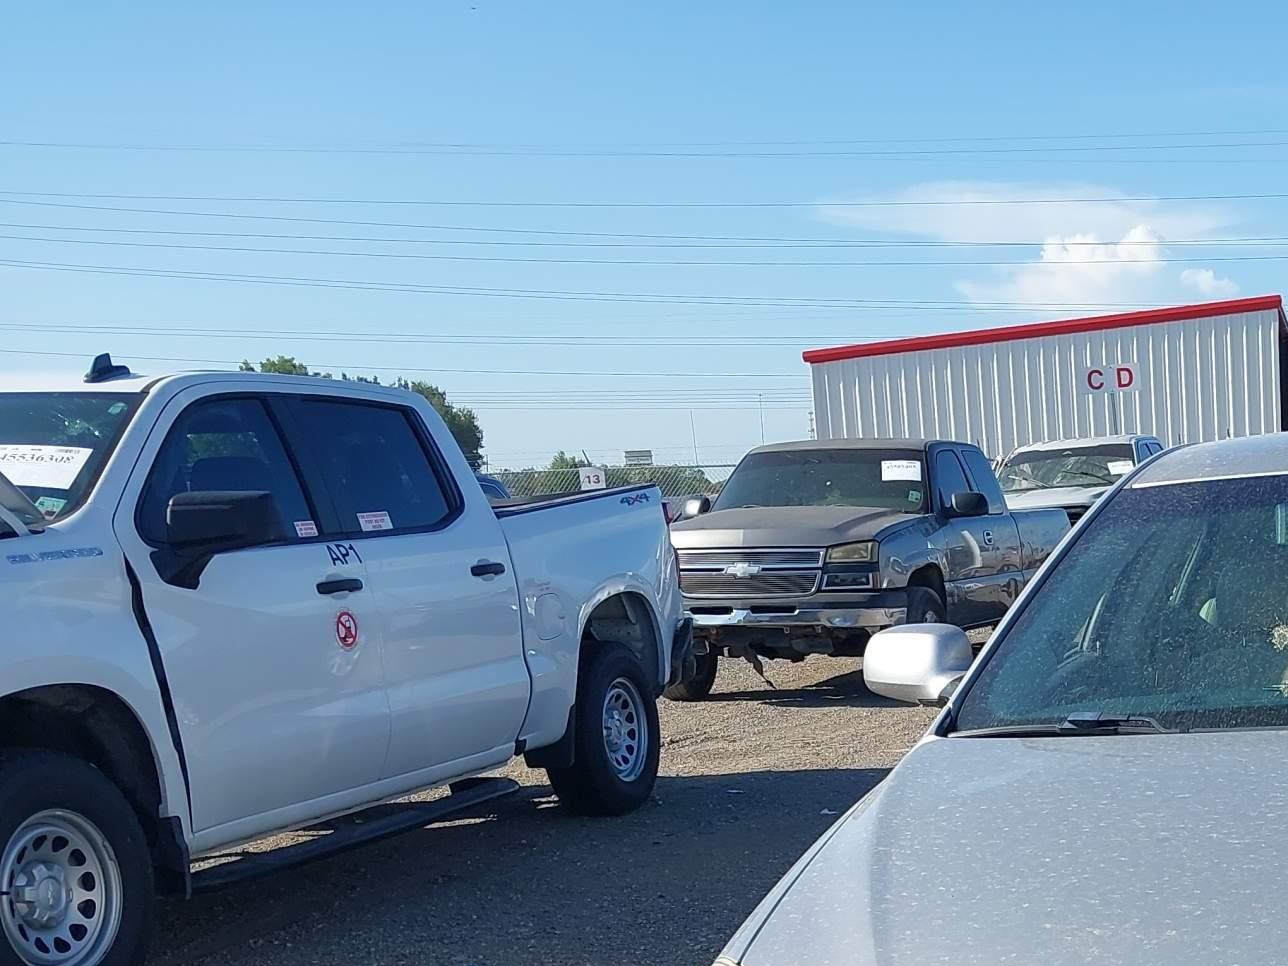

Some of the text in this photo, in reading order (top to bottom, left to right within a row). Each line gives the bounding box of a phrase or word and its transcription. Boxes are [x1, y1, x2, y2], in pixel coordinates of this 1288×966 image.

[1087, 367, 1134, 390] C D
[585, 474, 601, 485] 13
[326, 543, 363, 566] AP1
